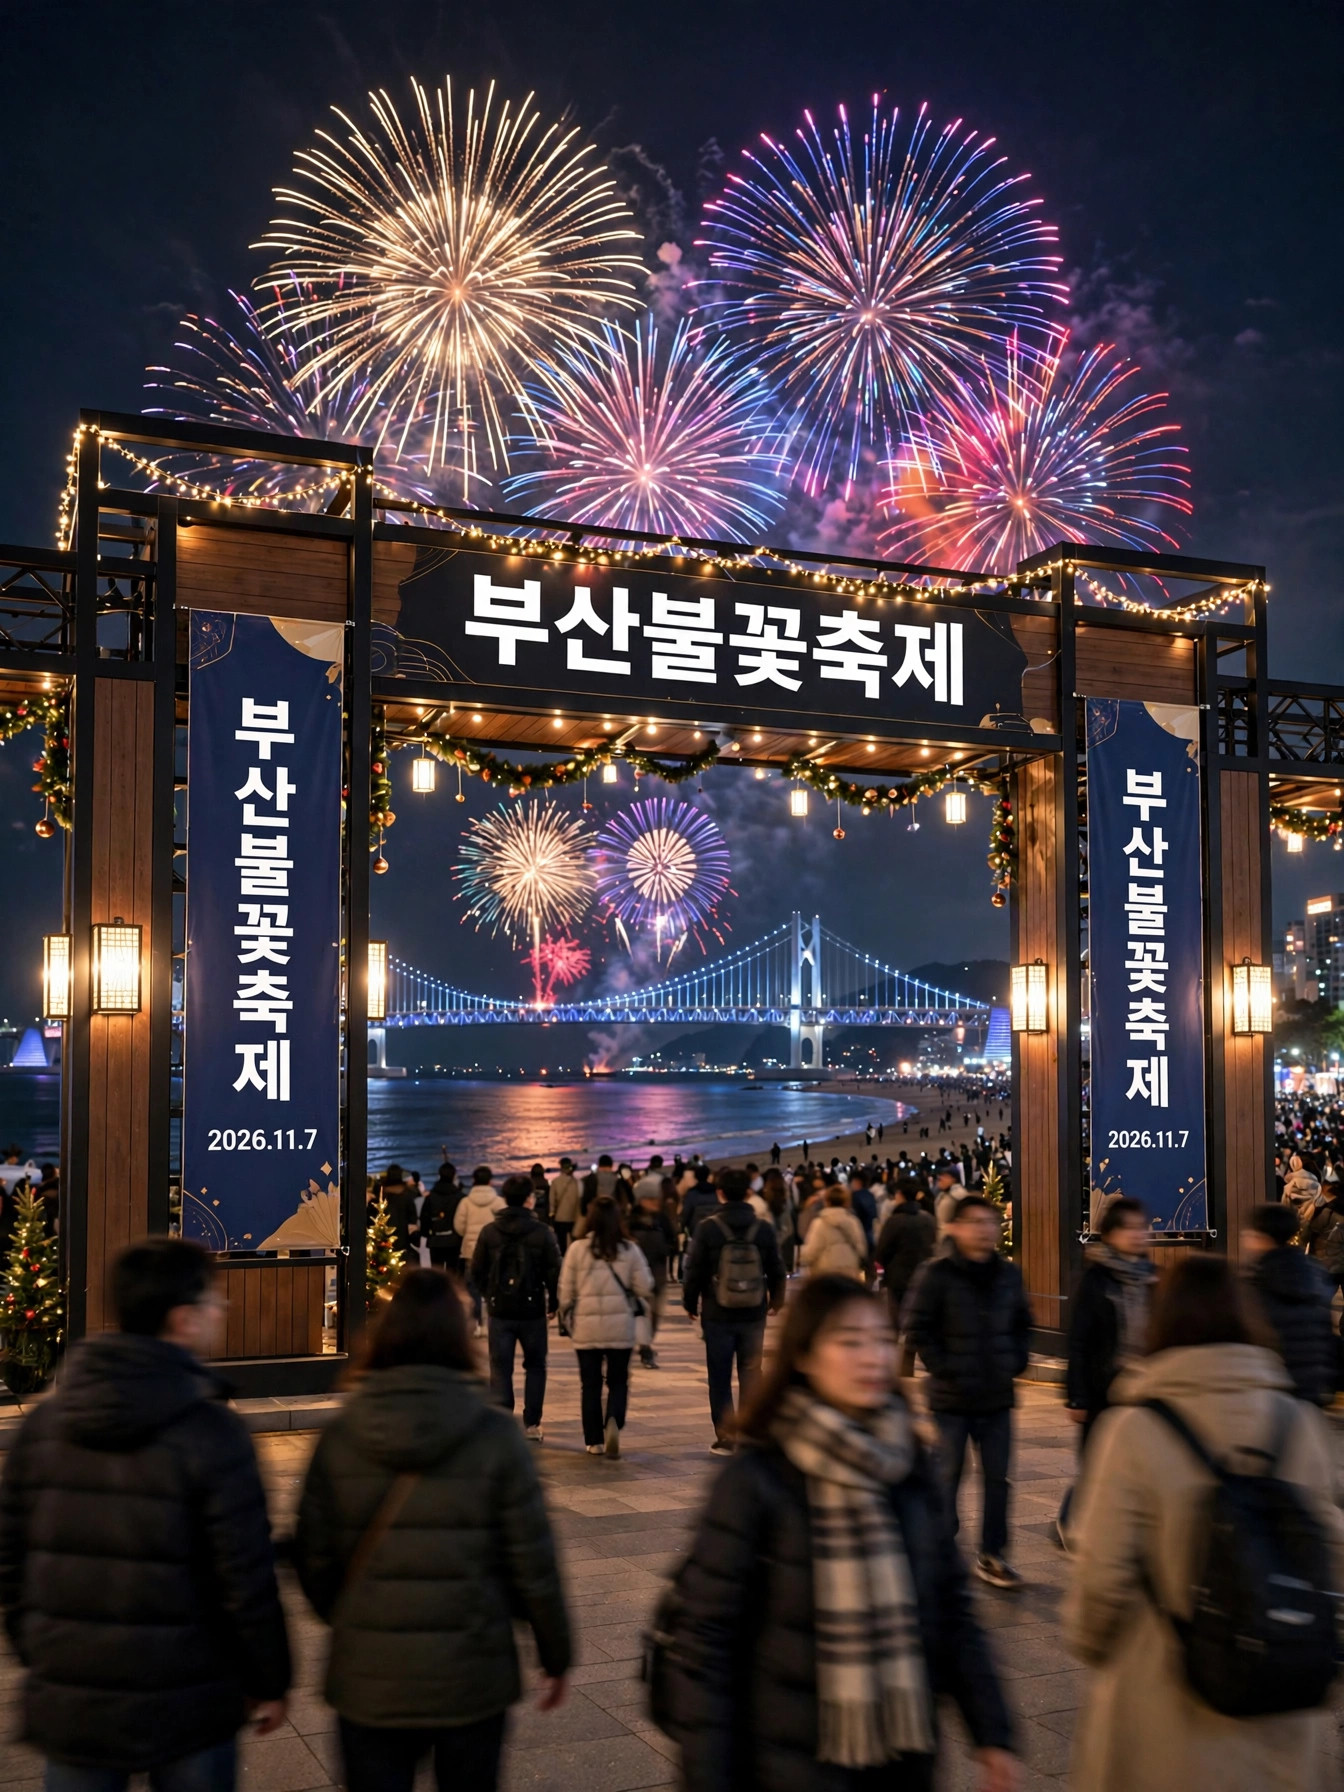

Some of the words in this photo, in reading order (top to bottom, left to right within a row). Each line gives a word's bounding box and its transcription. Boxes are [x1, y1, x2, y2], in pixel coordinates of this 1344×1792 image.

[464, 574, 964, 706] 부산불꽃축제
[232, 697, 297, 1102] 부산불꽃축제
[1122, 768, 1170, 1108] 부산불꽃축제
[207, 1129, 318, 1151] 2026.11.7
[1107, 1130, 1189, 1149] 2026.11.7
